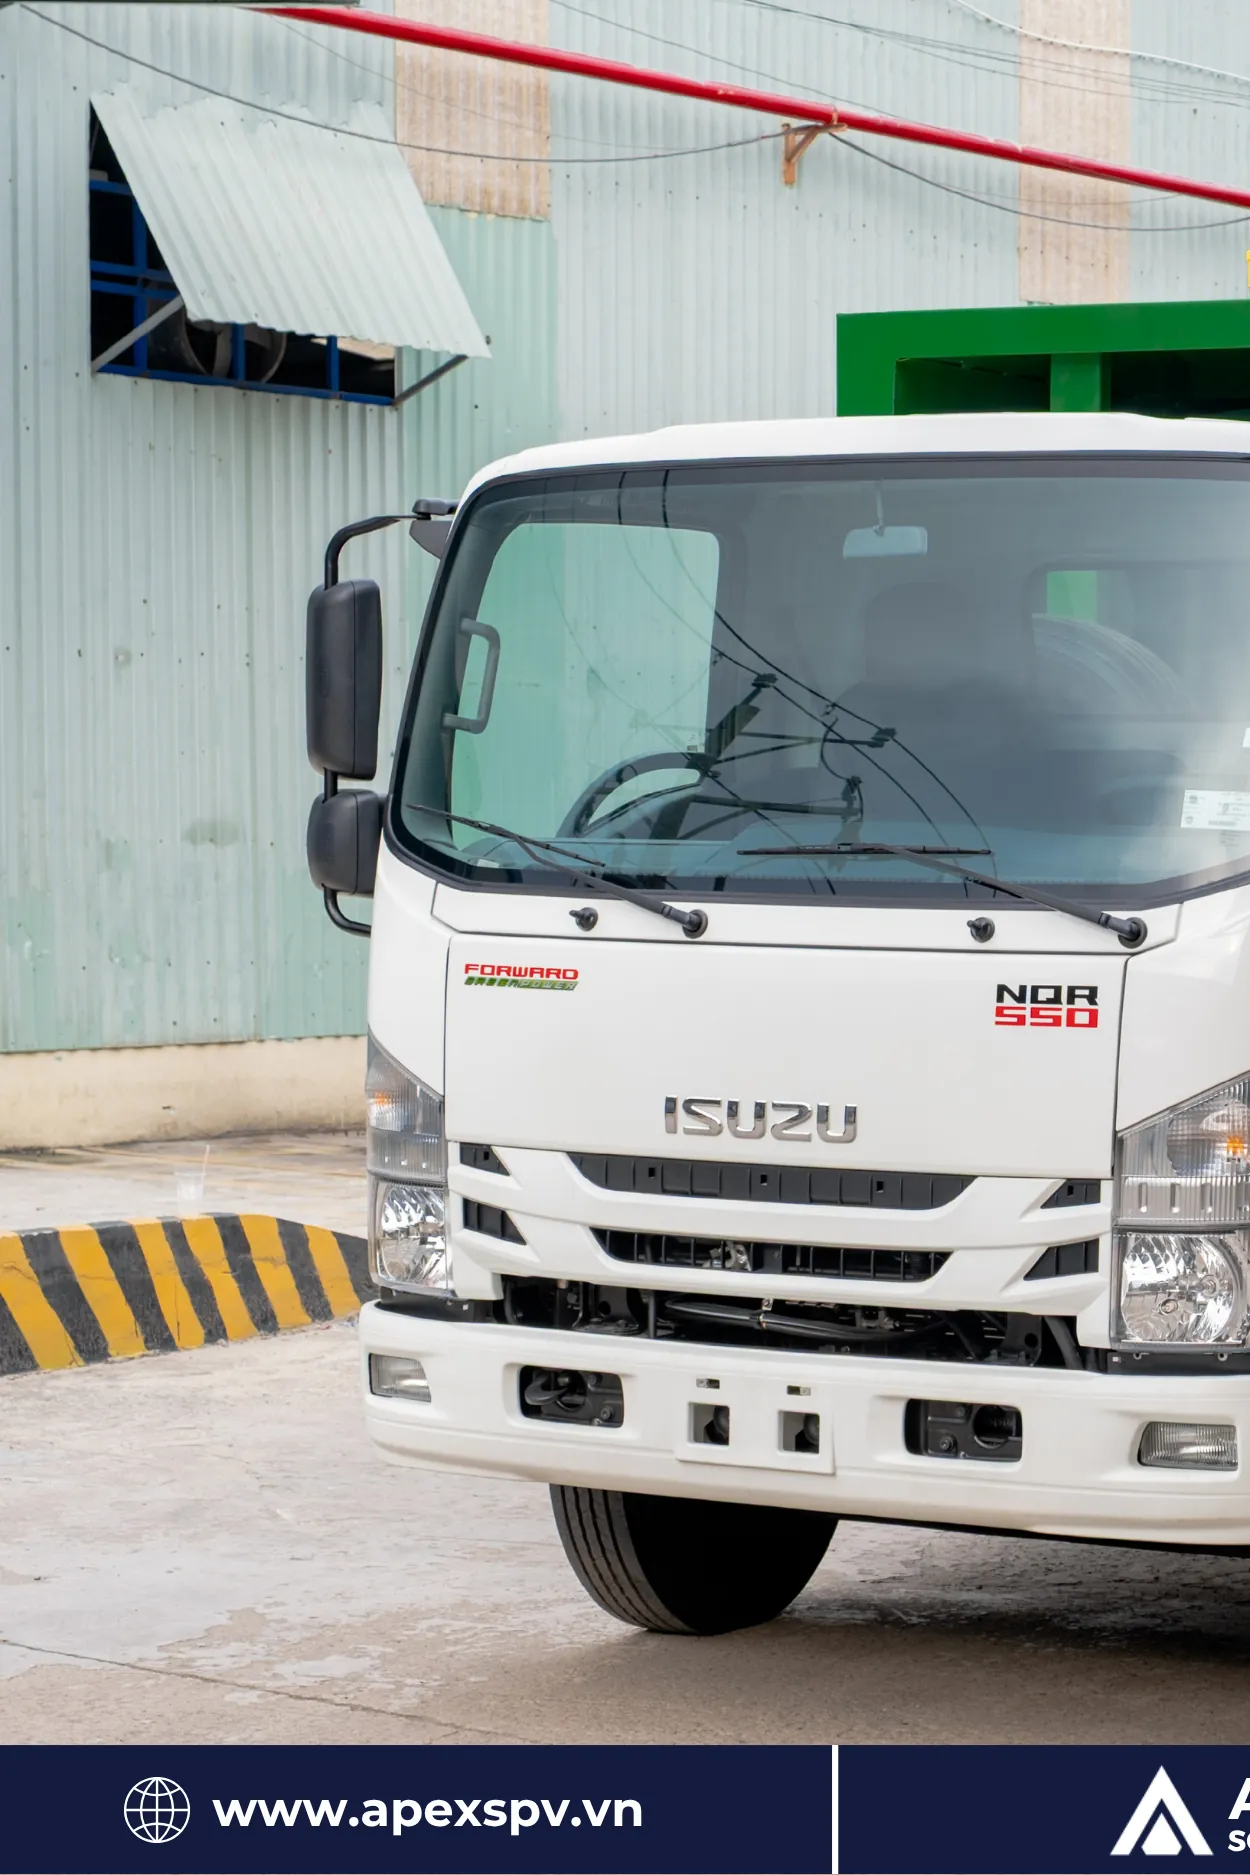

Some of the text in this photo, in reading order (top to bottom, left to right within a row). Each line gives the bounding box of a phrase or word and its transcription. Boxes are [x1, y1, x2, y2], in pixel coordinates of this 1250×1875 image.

[464, 963, 579, 980] FORWARD
[996, 984, 1099, 1006] NQR
[995, 1006, 1099, 1028] 550
[664, 1095, 857, 1144] ISUZU
